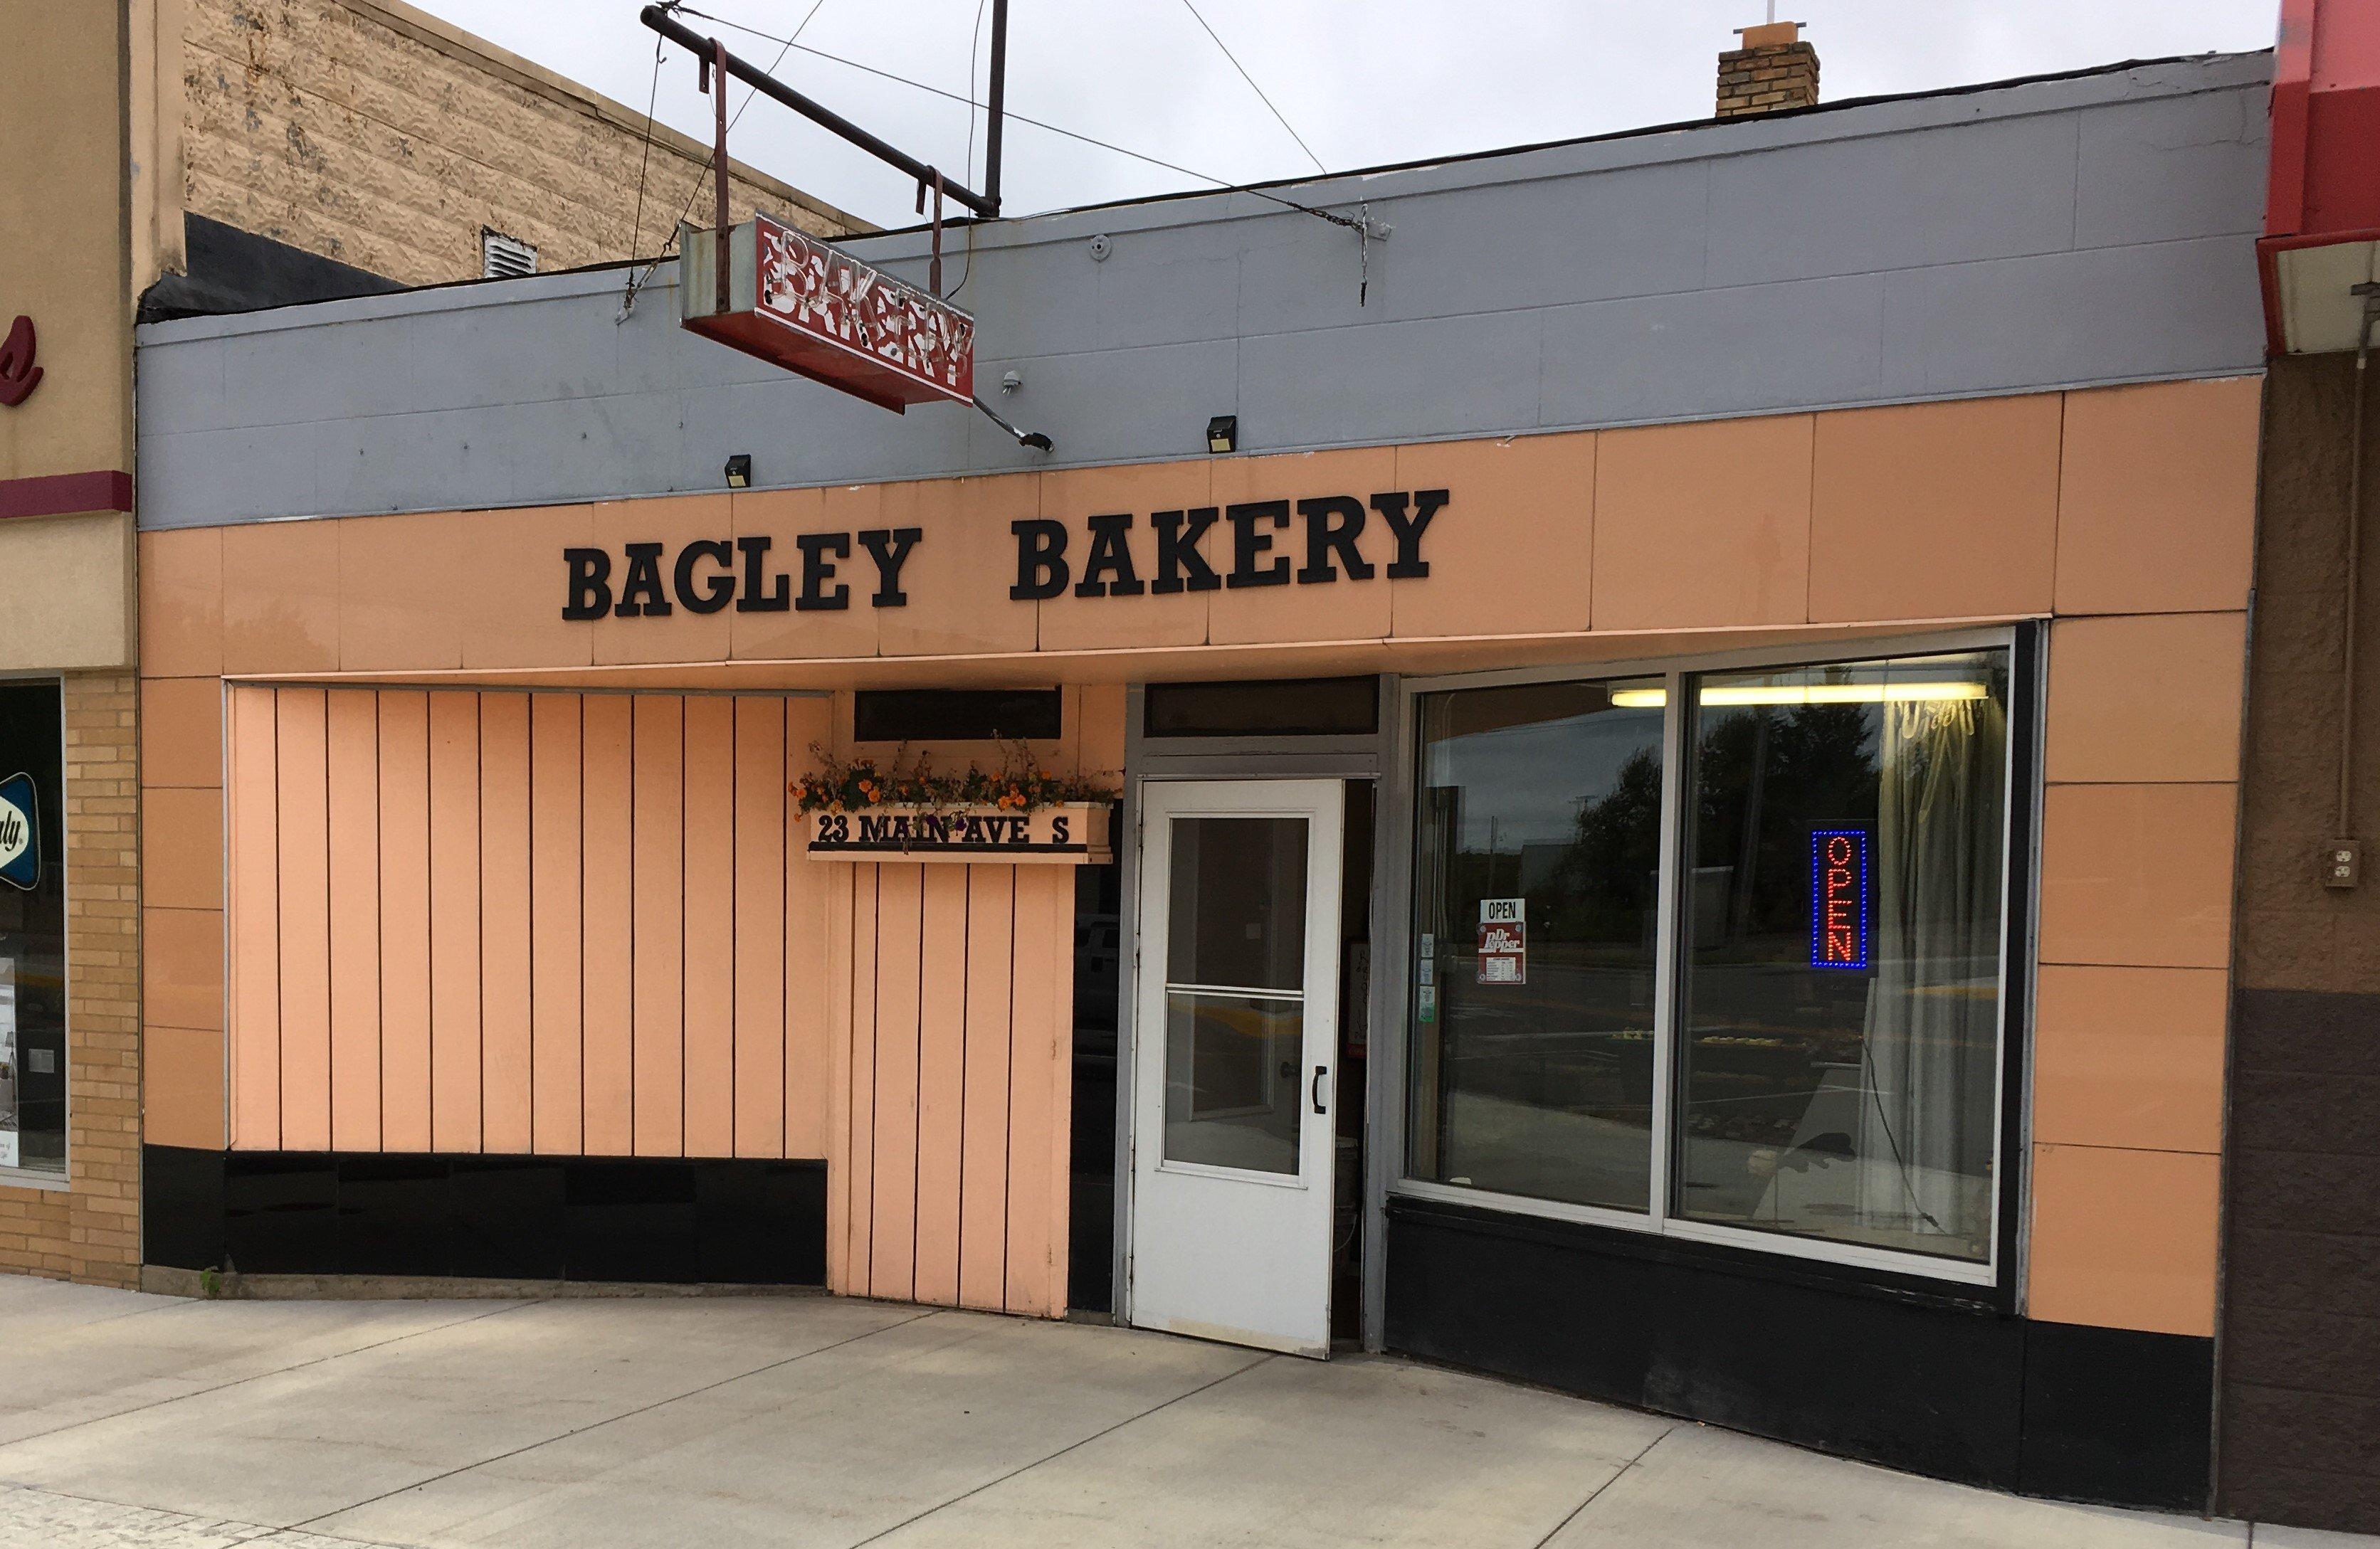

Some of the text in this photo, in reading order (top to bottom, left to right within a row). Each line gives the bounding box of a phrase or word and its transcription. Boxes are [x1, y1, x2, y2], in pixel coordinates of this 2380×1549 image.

[763, 231, 974, 387] BAKERY
[562, 489, 1449, 620] BAGLEY BAKERY
[818, 815, 1070, 844] 23 MAIN AVE S
[1488, 901, 1517, 920] OPEN
[1827, 835, 1853, 962] OPEN
[1483, 931, 1520, 953] Pepper
[1496, 928, 1510, 941] Dr
